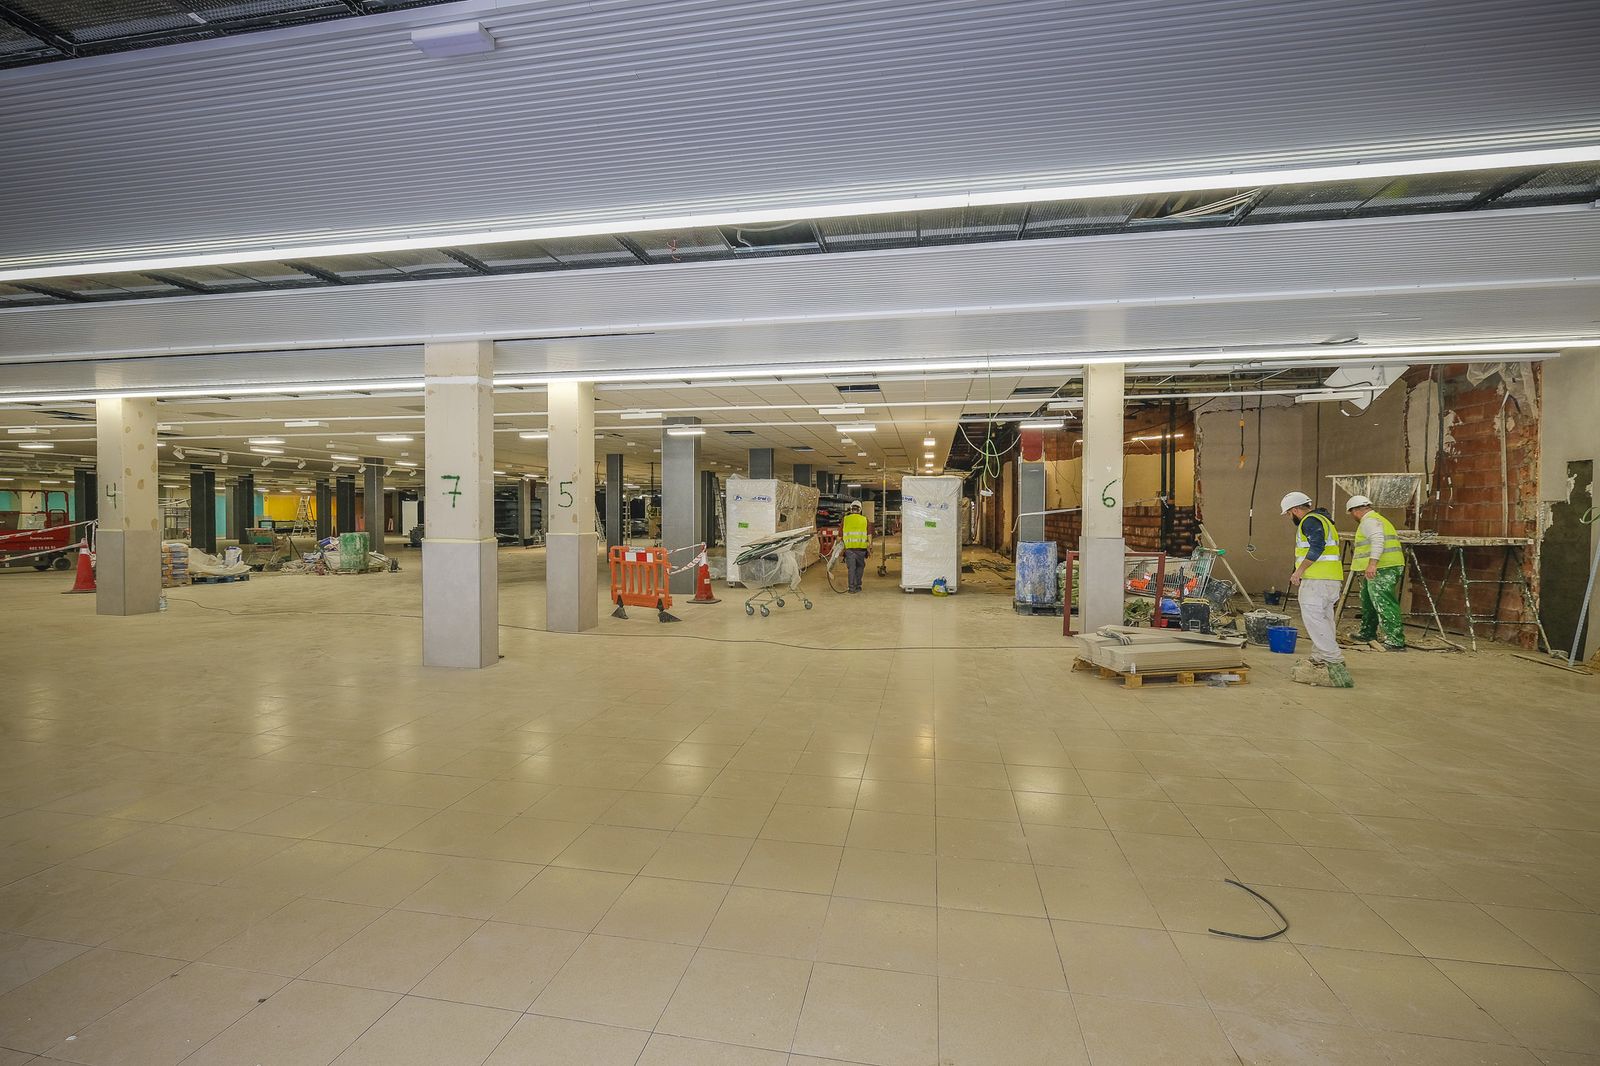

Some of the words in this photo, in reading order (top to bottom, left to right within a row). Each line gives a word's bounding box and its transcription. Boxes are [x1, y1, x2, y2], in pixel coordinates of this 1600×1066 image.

[106, 482, 117, 510] 4
[441, 475, 462, 508] 7
[558, 481, 573, 508] 5
[1102, 479, 1117, 508] 6
